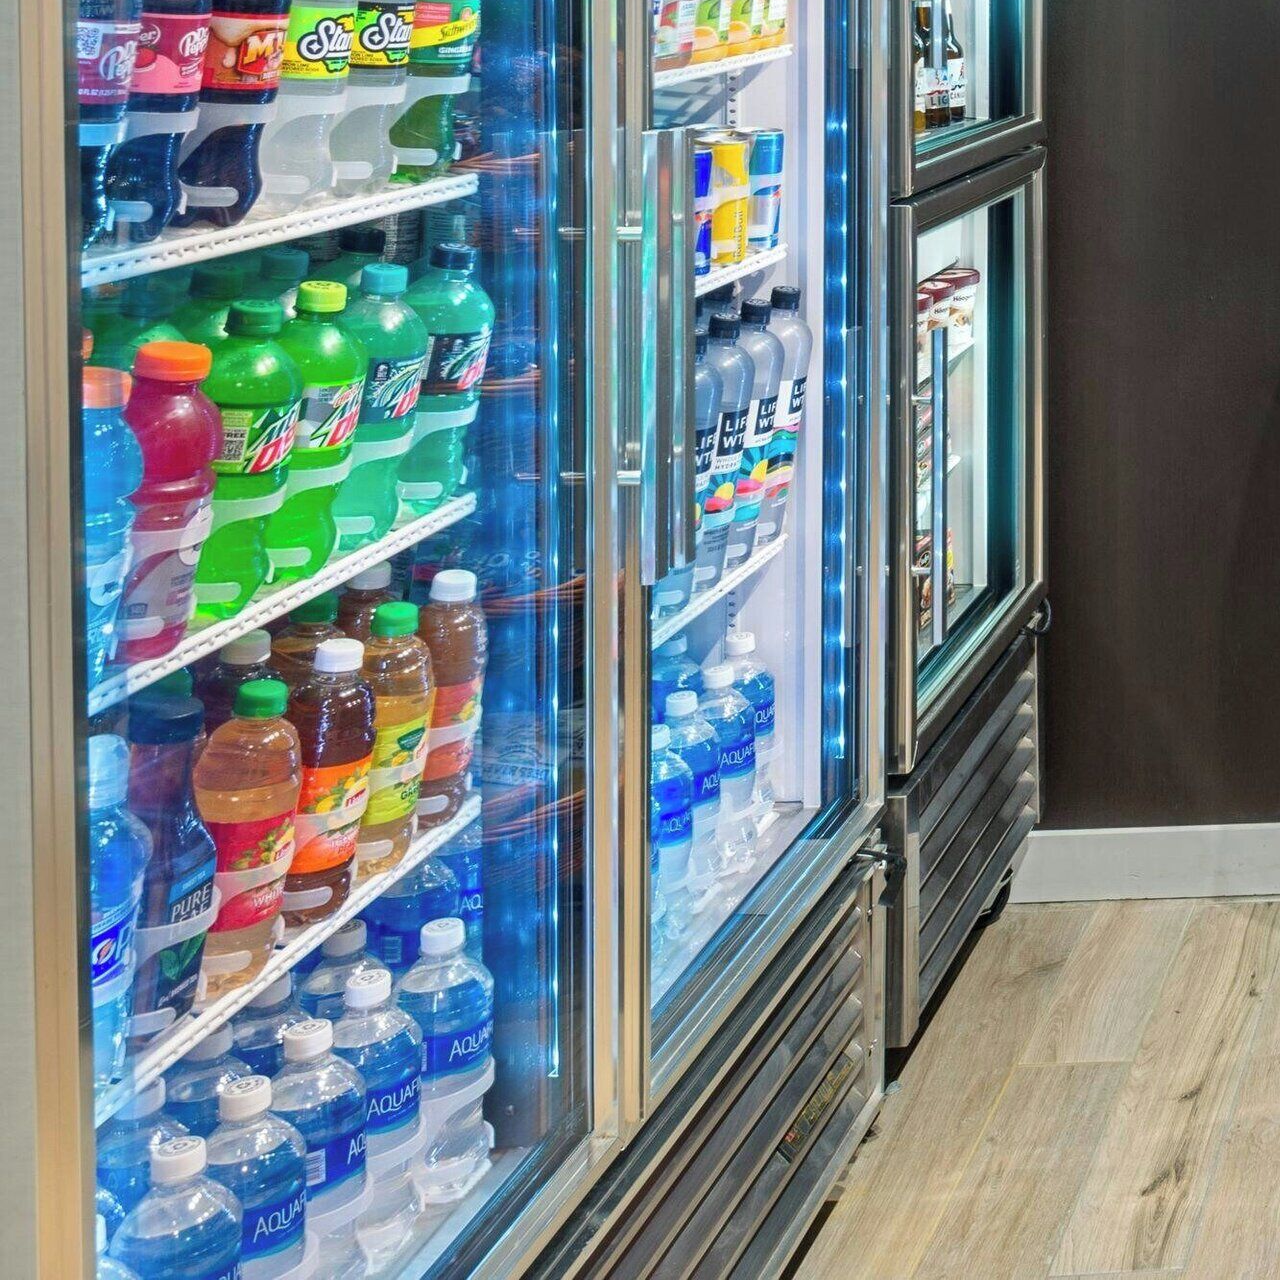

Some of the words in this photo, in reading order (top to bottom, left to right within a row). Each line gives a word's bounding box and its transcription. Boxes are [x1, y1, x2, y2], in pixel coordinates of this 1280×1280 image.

[733, 210, 744, 234] Bull
[725, 416, 748, 432] LIF
[723, 433, 744, 449] WT
[171, 883, 211, 917] PURE
[367, 1077, 421, 1122] AQUAF
[253, 1190, 306, 1243] AQUAF
